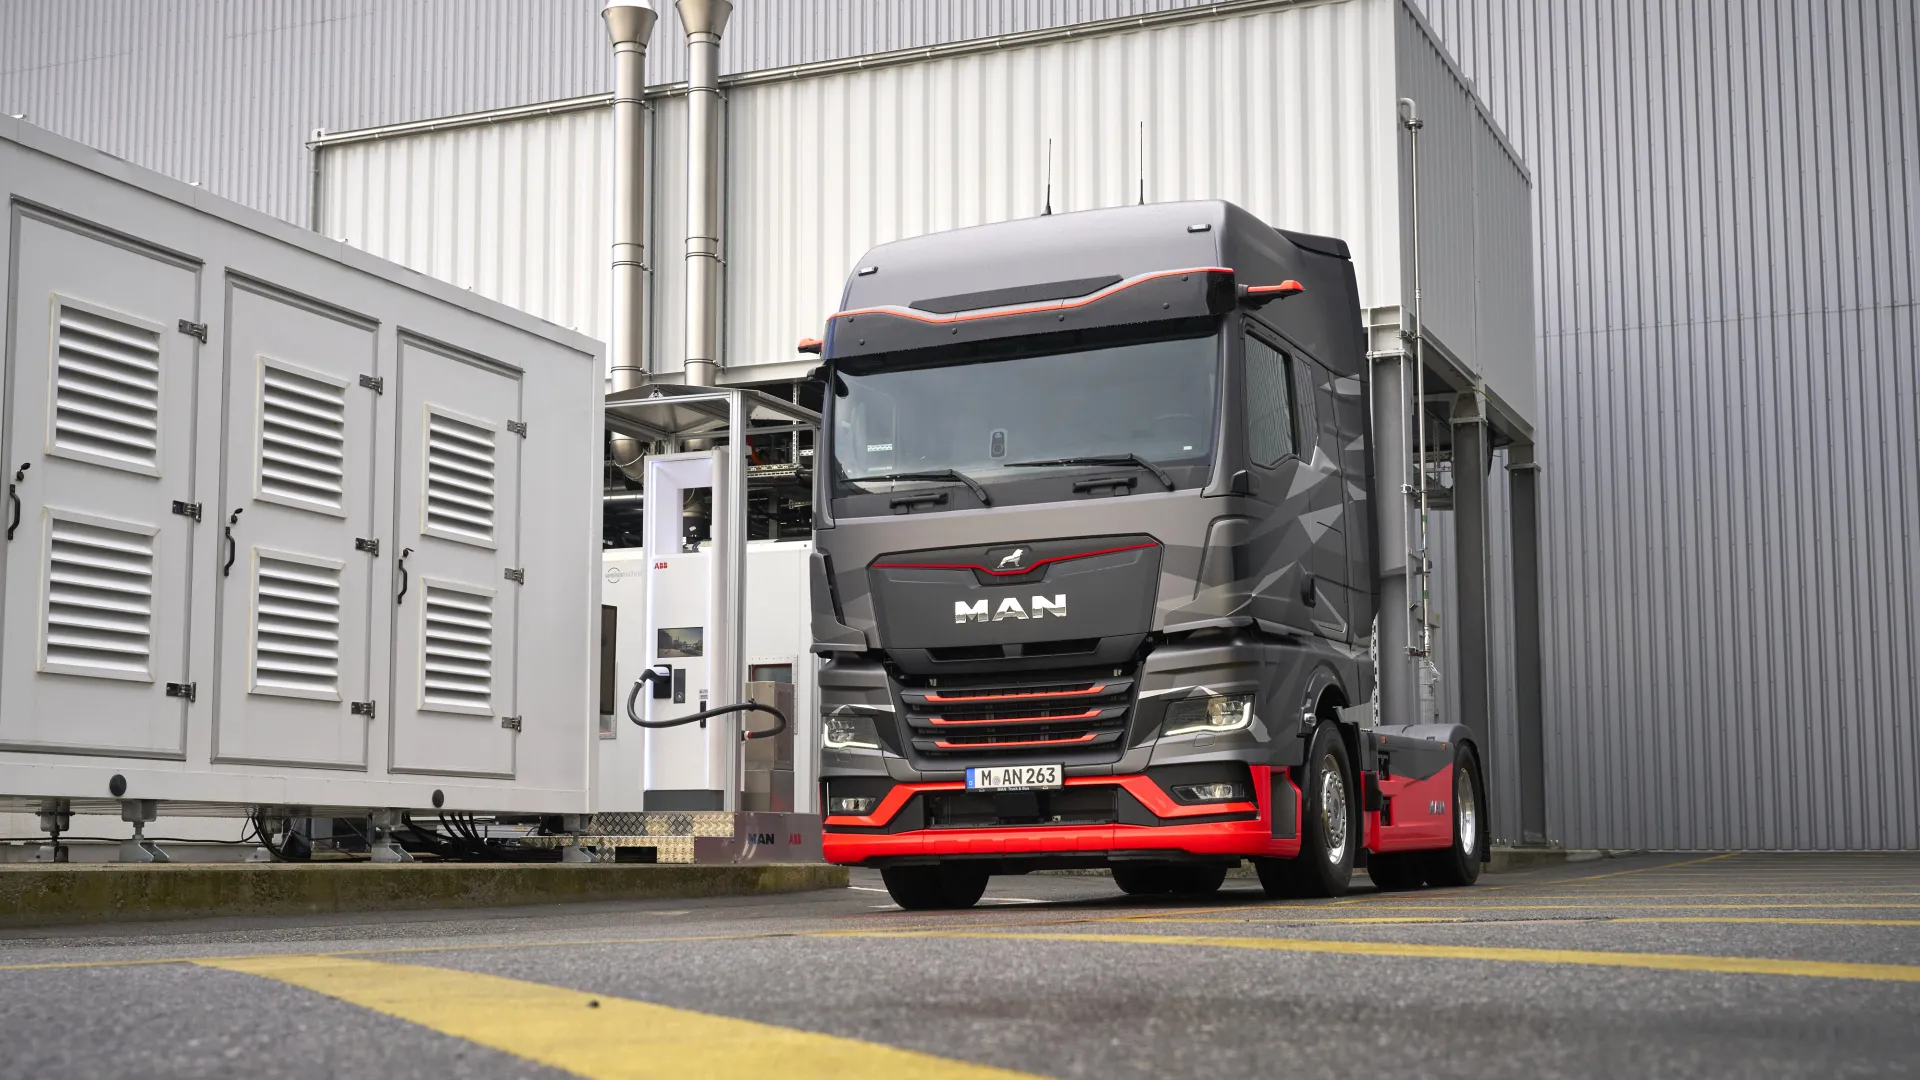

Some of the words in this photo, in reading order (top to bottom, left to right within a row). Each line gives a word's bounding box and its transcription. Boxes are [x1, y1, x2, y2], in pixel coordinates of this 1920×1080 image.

[654, 562, 668, 570] ABB
[955, 594, 1067, 624] MAN
[981, 770, 992, 786] M
[1026, 767, 1056, 784] 263
[748, 833, 775, 845] MAN
